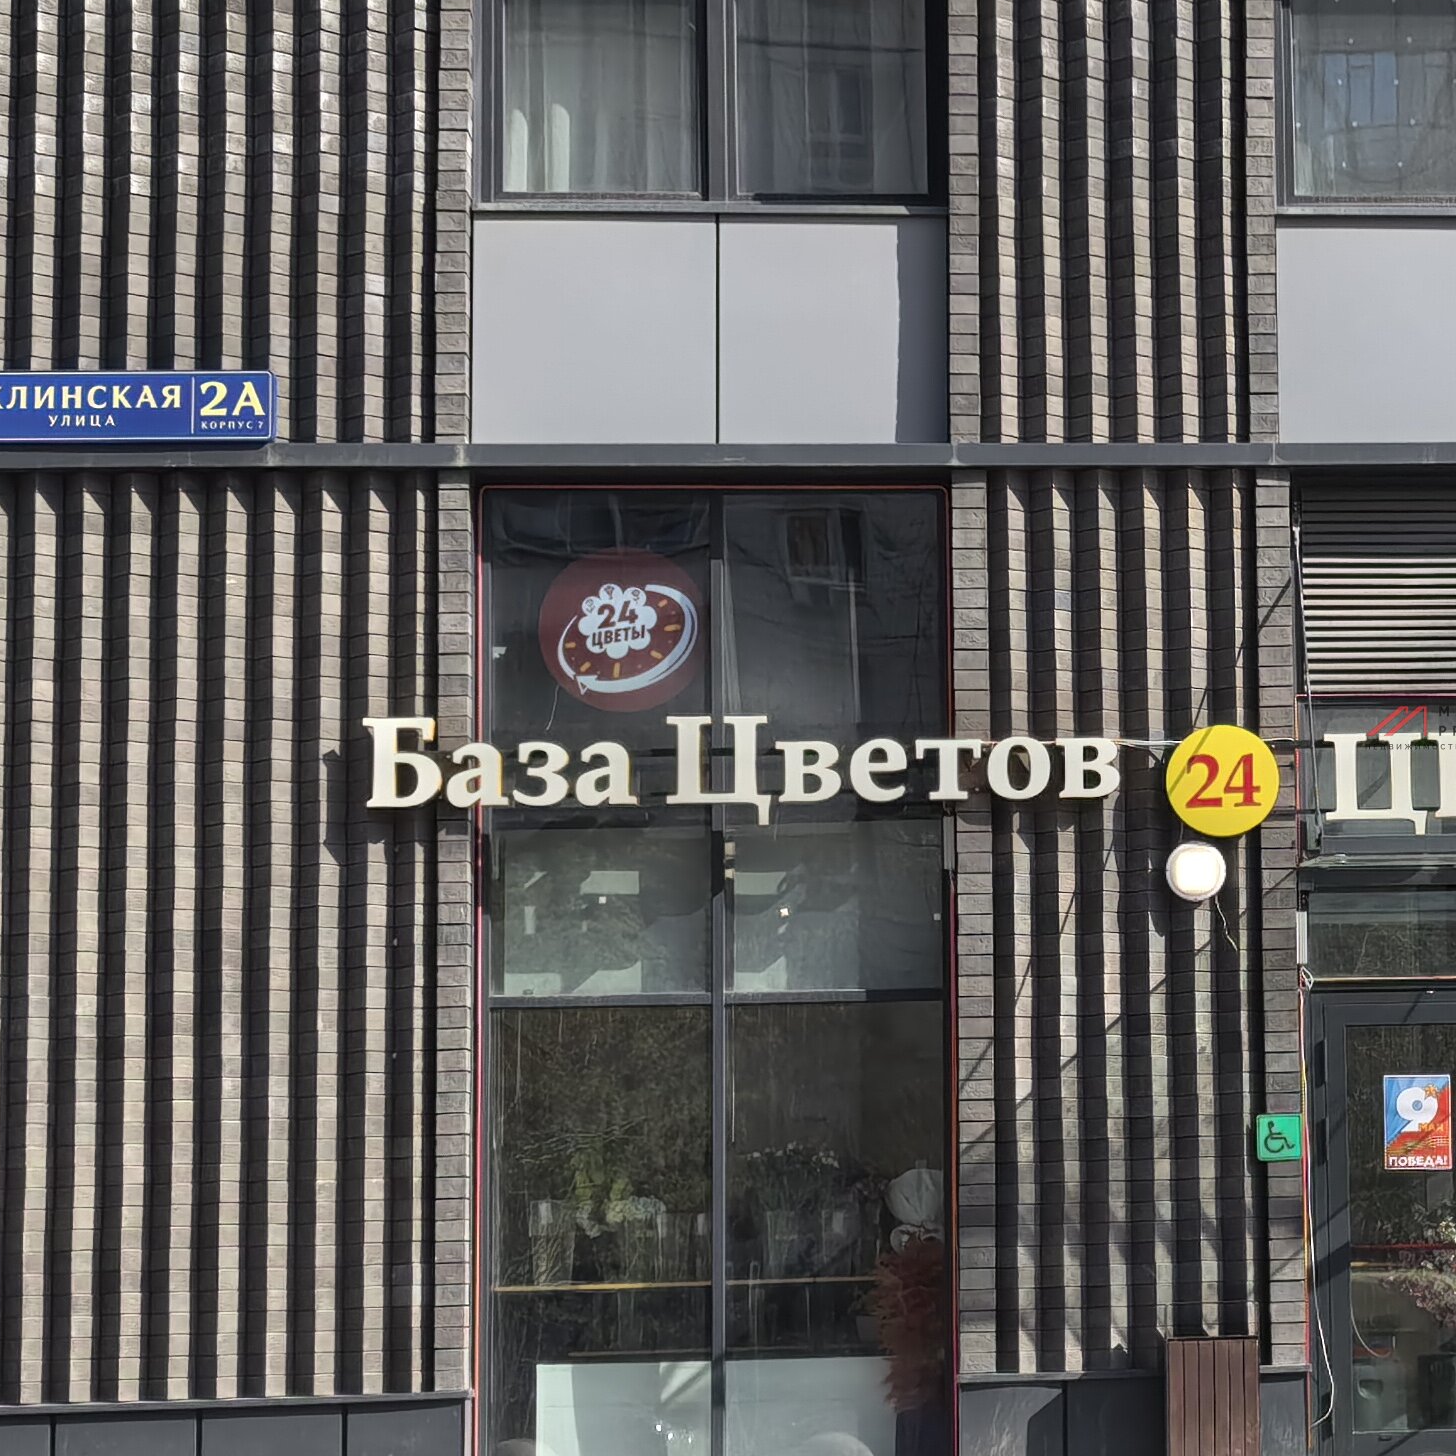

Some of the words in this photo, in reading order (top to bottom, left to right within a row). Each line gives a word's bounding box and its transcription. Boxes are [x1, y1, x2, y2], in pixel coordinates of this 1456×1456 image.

[200, 381, 266, 416] 2А
[48, 414, 116, 427] УЛИЦА
[201, 420, 253, 430] КОРПУС
[598, 600, 639, 631] 24
[592, 624, 646, 649] ЦВЕТЫ
[363, 717, 639, 809] База
[666, 715, 1121, 826] Цветов
[1184, 752, 1261, 809] 24
[1396, 1086, 1439, 1132] 9
[1389, 1155, 1448, 1167] ПОБЕДА!
